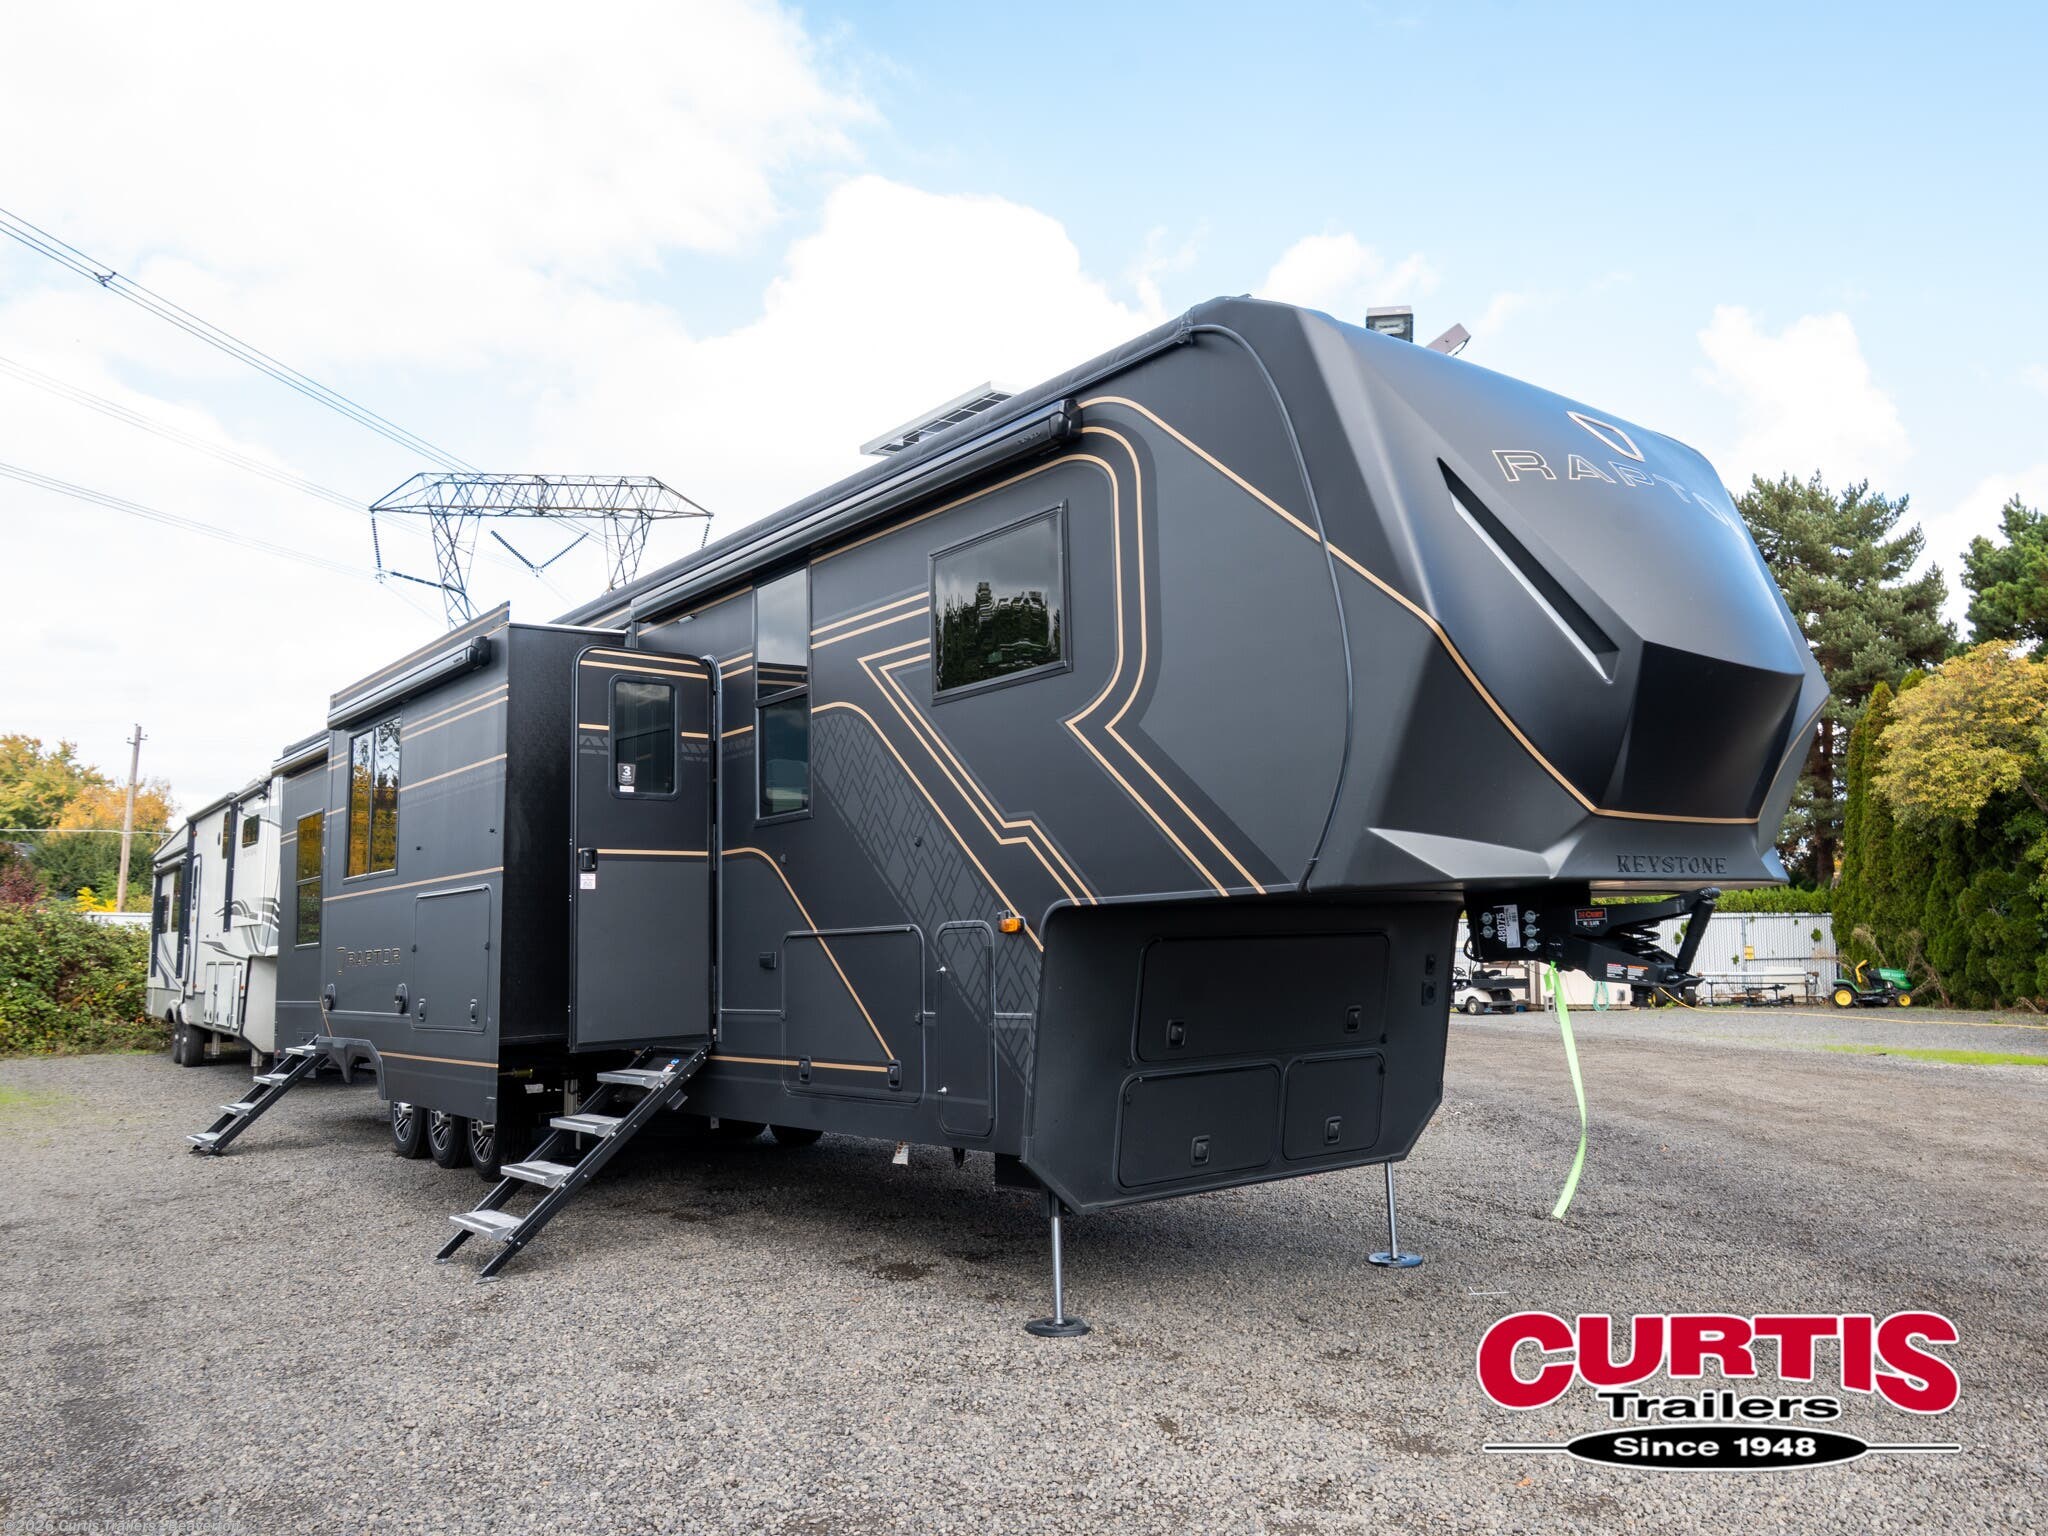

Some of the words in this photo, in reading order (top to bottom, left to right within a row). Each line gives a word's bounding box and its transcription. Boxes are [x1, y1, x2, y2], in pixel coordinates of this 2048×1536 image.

[622, 765, 631, 776] 3
[1616, 855, 1728, 874] KEYSTONE
[1496, 911, 1508, 942] 48075
[347, 947, 401, 967] RAPTOR
